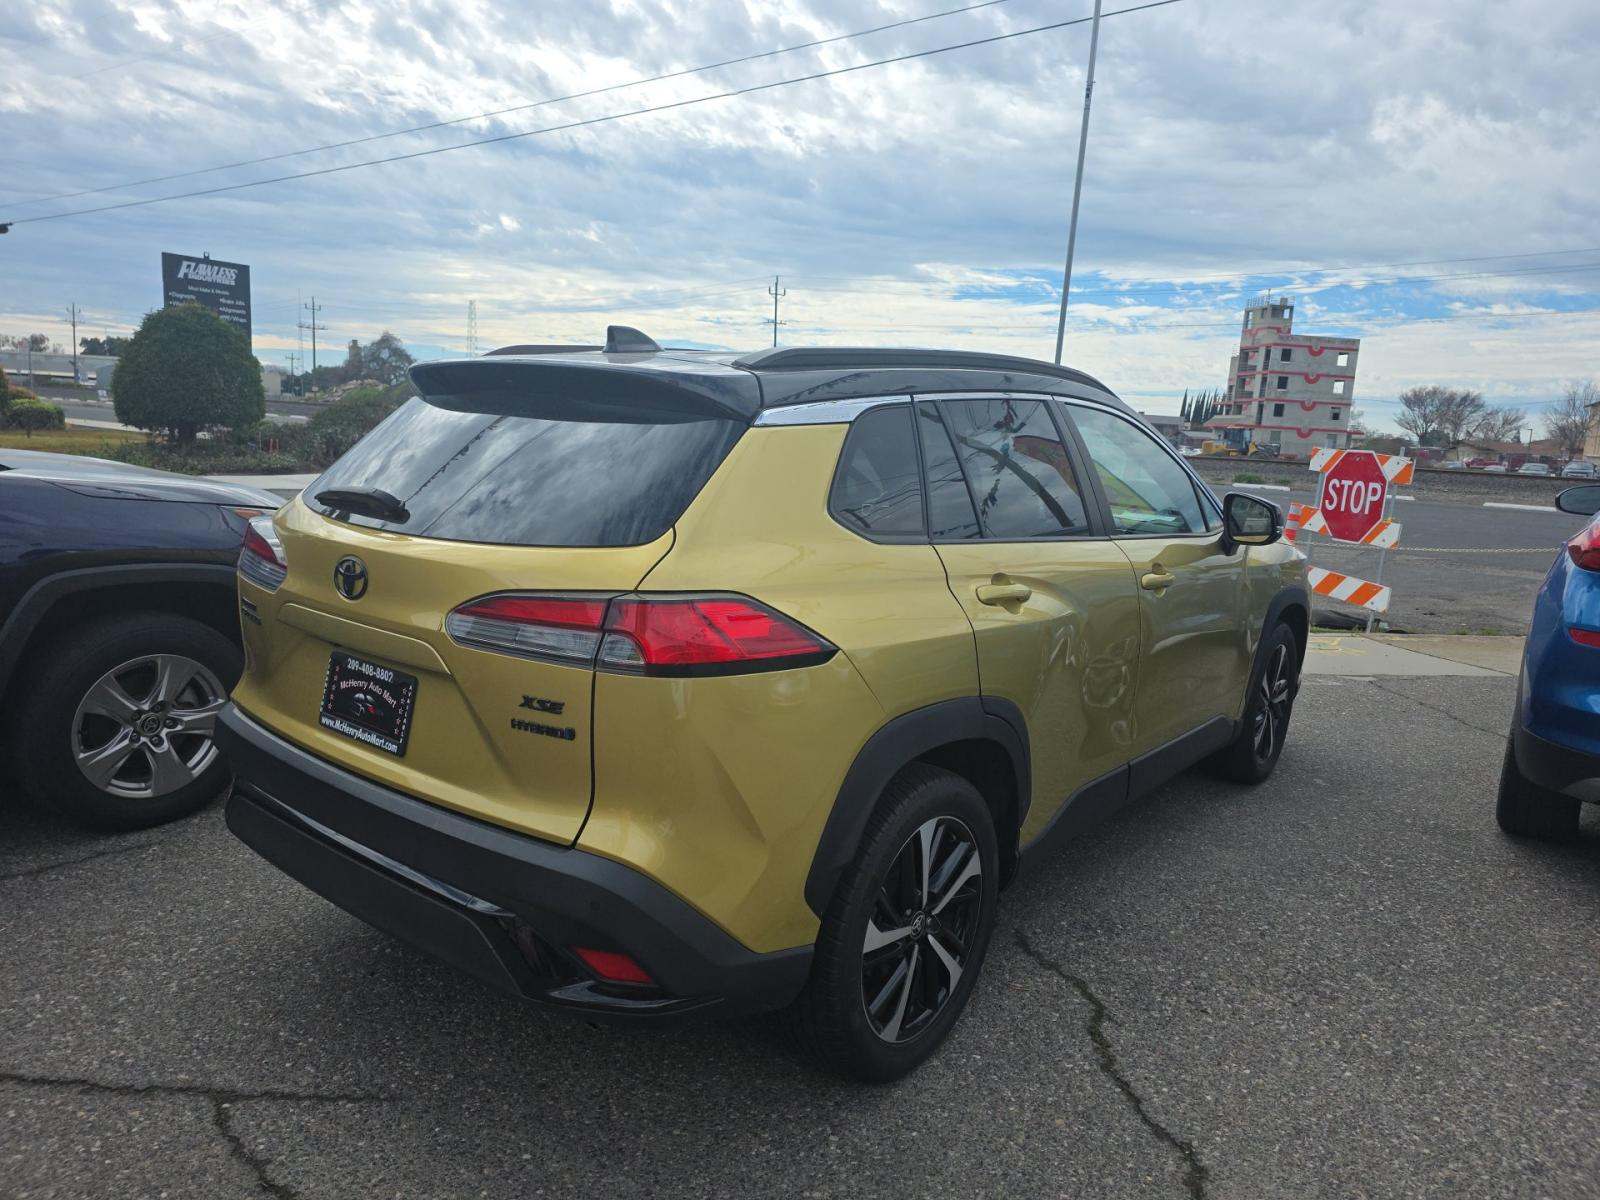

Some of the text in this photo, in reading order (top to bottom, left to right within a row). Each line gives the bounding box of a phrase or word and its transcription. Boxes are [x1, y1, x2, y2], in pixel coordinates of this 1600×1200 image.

[178, 261, 238, 280] FLAWLESS
[1325, 478, 1382, 515] STOP
[340, 679, 397, 708] McHenry Auto Mart
[518, 695, 565, 715] XSE
[320, 716, 398, 754] www.McHenryAutoMart.com
